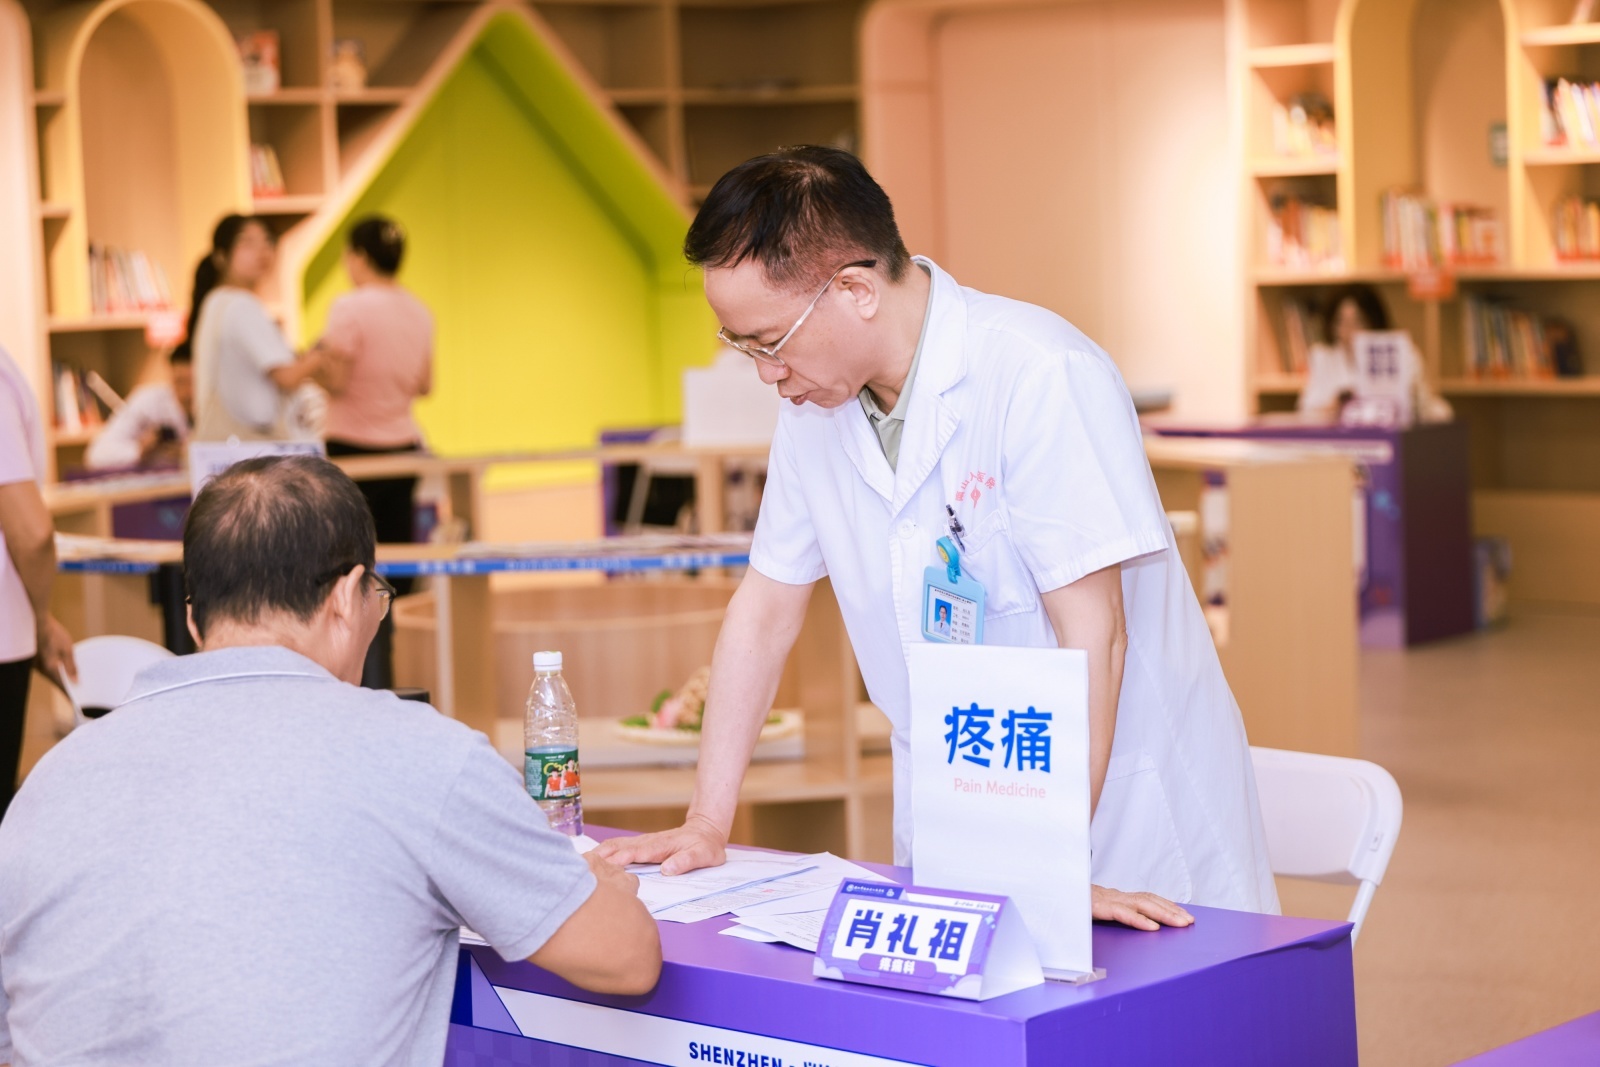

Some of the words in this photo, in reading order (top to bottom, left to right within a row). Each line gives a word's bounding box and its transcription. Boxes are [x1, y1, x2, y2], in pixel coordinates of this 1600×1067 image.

[944, 702, 1053, 773] 疼痛
[954, 777, 982, 794] Pain
[986, 780, 1046, 798] Medicine
[845, 909, 969, 961] 肖礼祖
[689, 1041, 782, 1067] SHENZHEN
